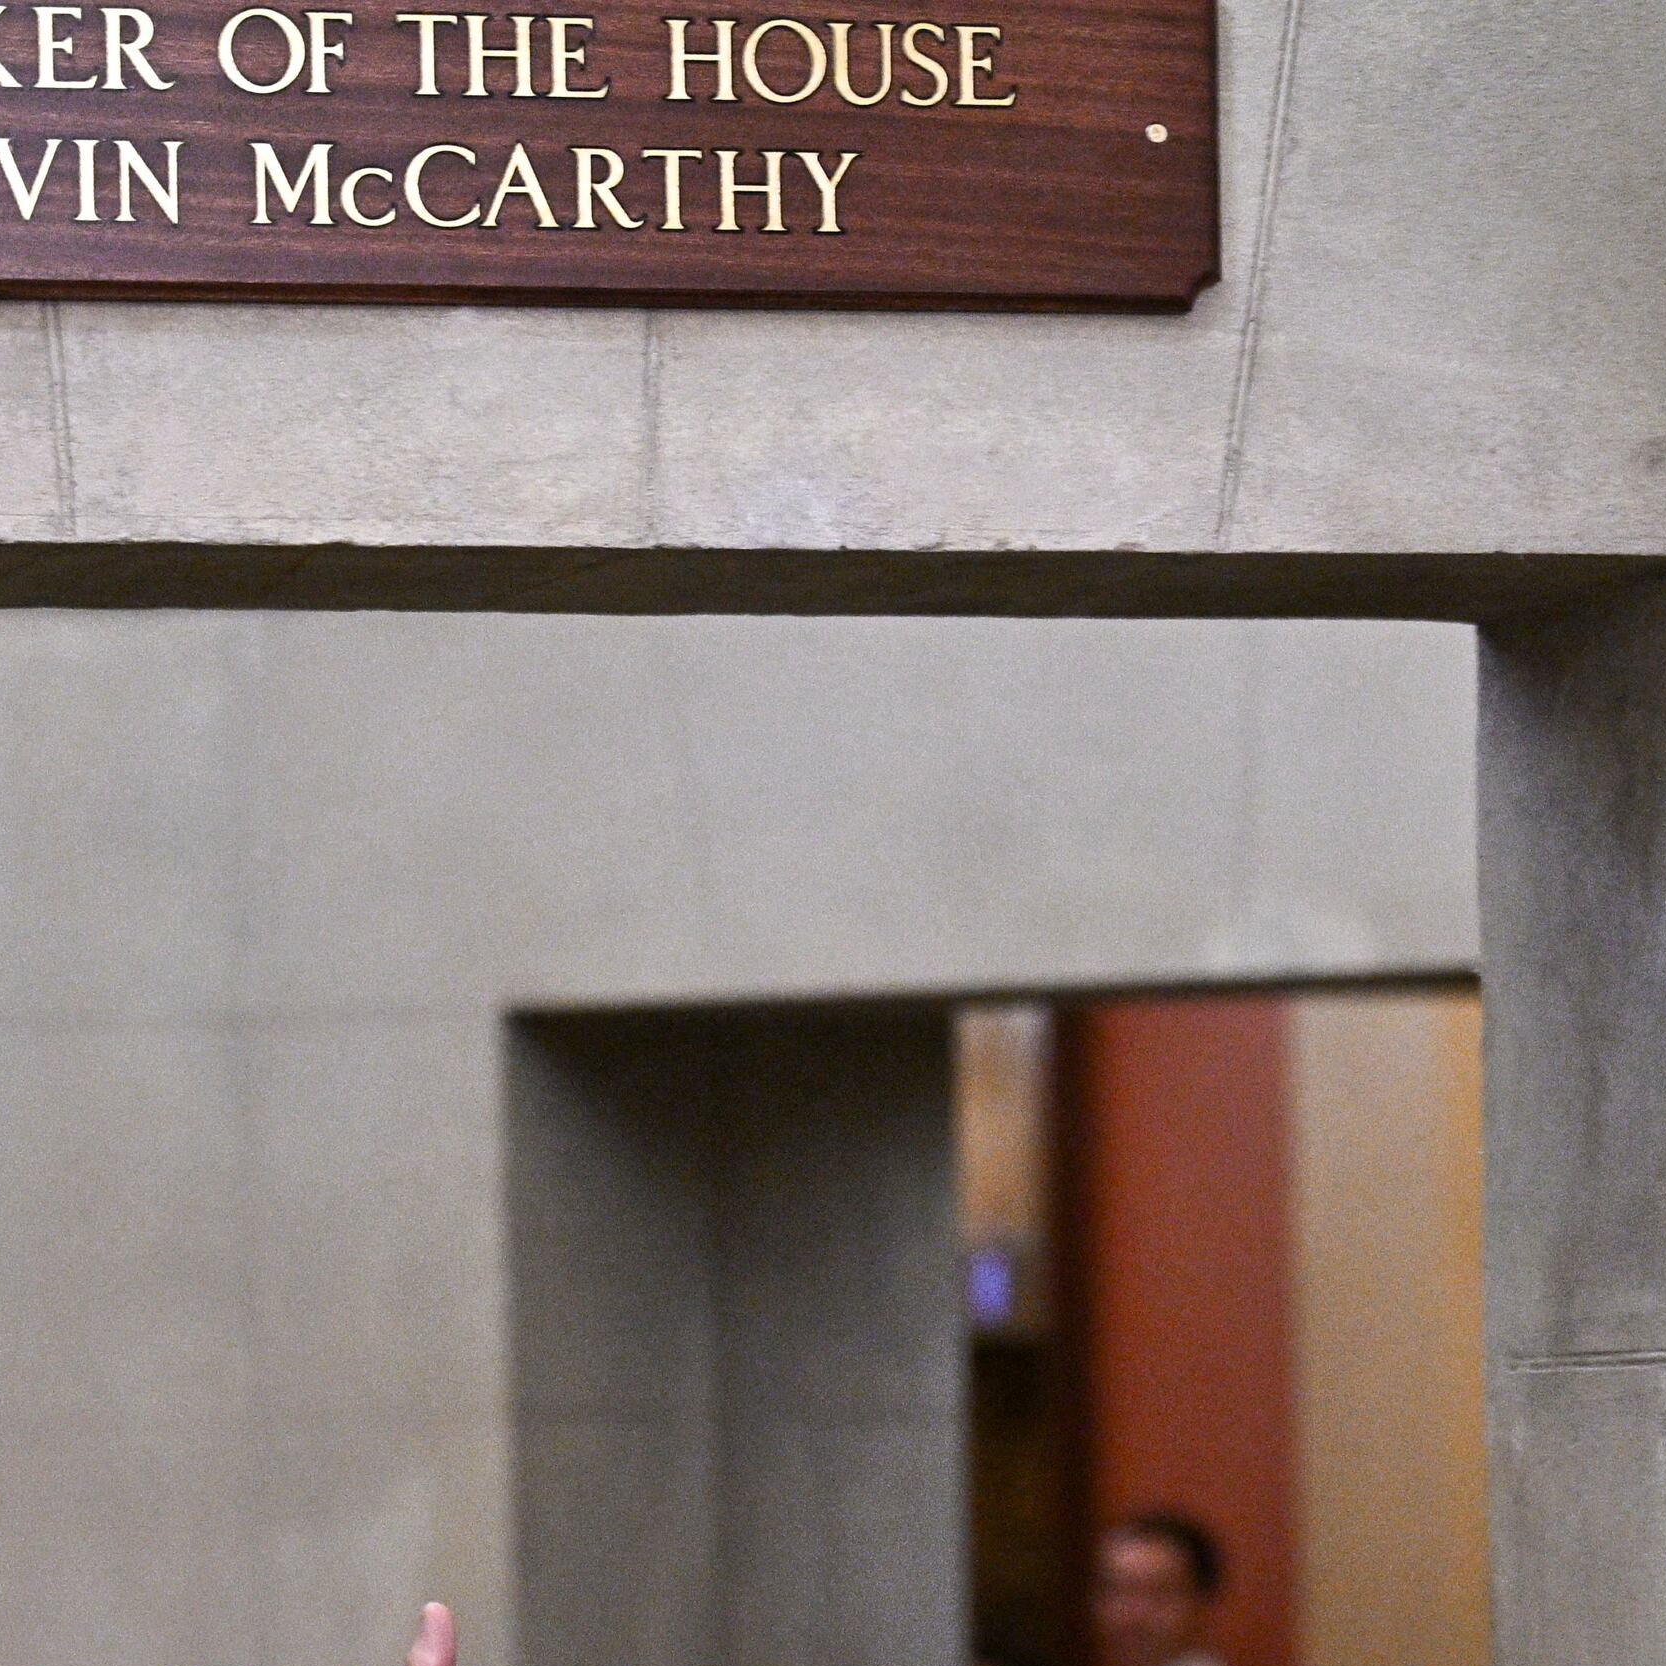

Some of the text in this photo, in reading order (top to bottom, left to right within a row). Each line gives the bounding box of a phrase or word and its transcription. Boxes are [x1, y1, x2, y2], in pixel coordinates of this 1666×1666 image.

[217, 6, 354, 96] OF
[396, 11, 610, 100] THE
[662, 17, 1017, 108] HOUSE
[247, 140, 863, 235] McCARTHY
